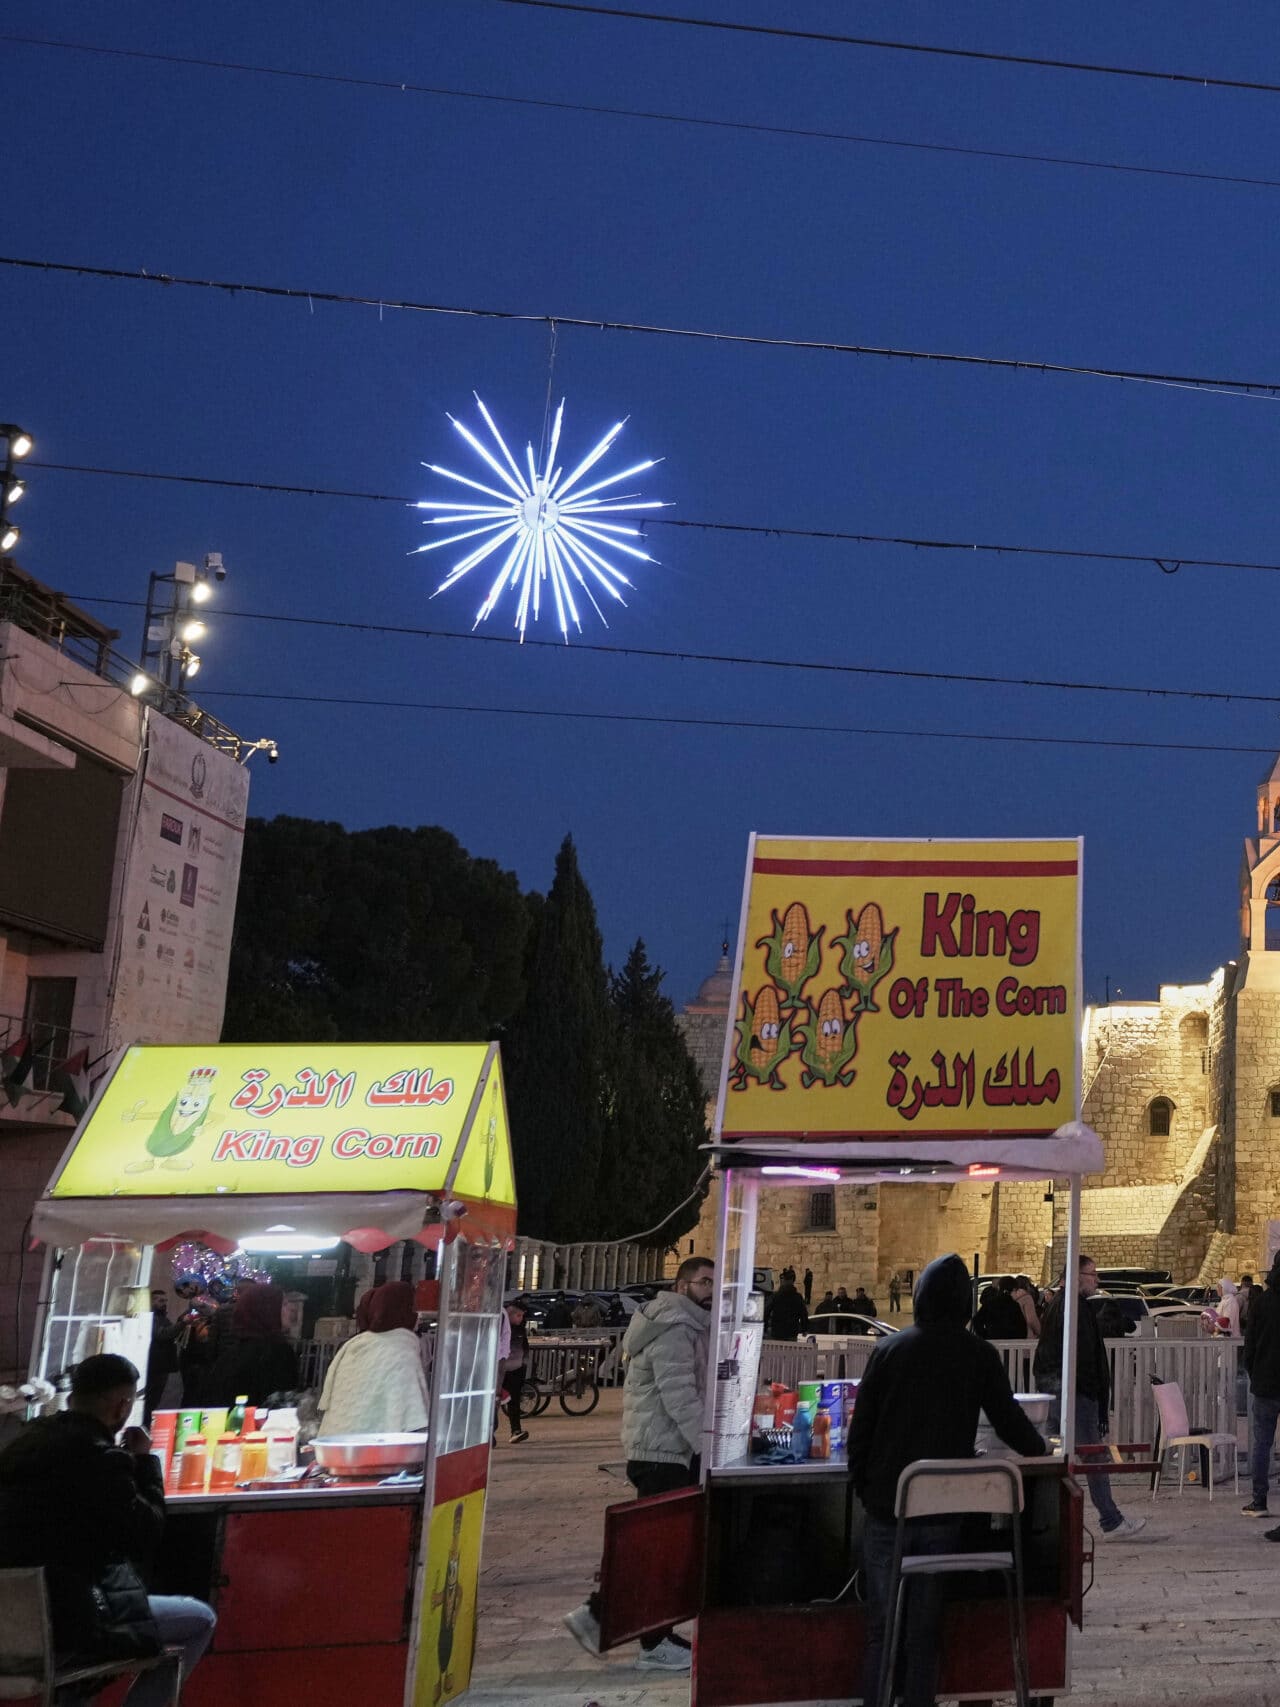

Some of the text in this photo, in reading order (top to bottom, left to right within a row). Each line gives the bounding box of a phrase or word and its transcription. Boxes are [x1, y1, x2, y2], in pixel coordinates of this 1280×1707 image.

[920, 892, 1041, 966] King
[889, 976, 1066, 1018] Of The Corn
[230, 1067, 455, 1118] ملك الذرة
[886, 1046, 1061, 1120] ملك الذرة
[212, 1127, 443, 1167] King Corn
